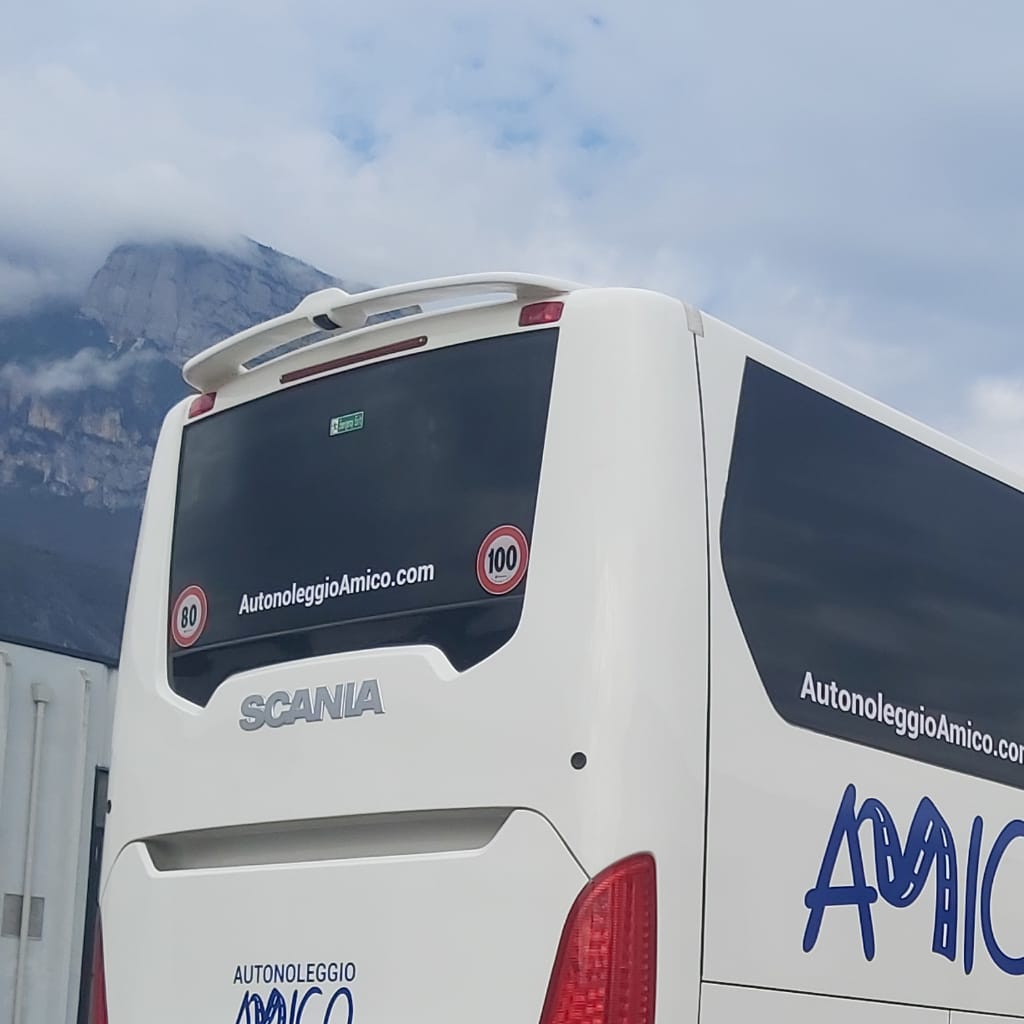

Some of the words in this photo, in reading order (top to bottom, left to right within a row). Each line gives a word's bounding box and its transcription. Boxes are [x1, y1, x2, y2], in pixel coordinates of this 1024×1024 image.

[487, 544, 518, 574] 100
[238, 563, 435, 615] AutonoleggioAmico.com
[181, 603, 197, 629] 80
[238, 679, 386, 732] SCANIA
[233, 962, 356, 985] AUTONOLEGGIO
